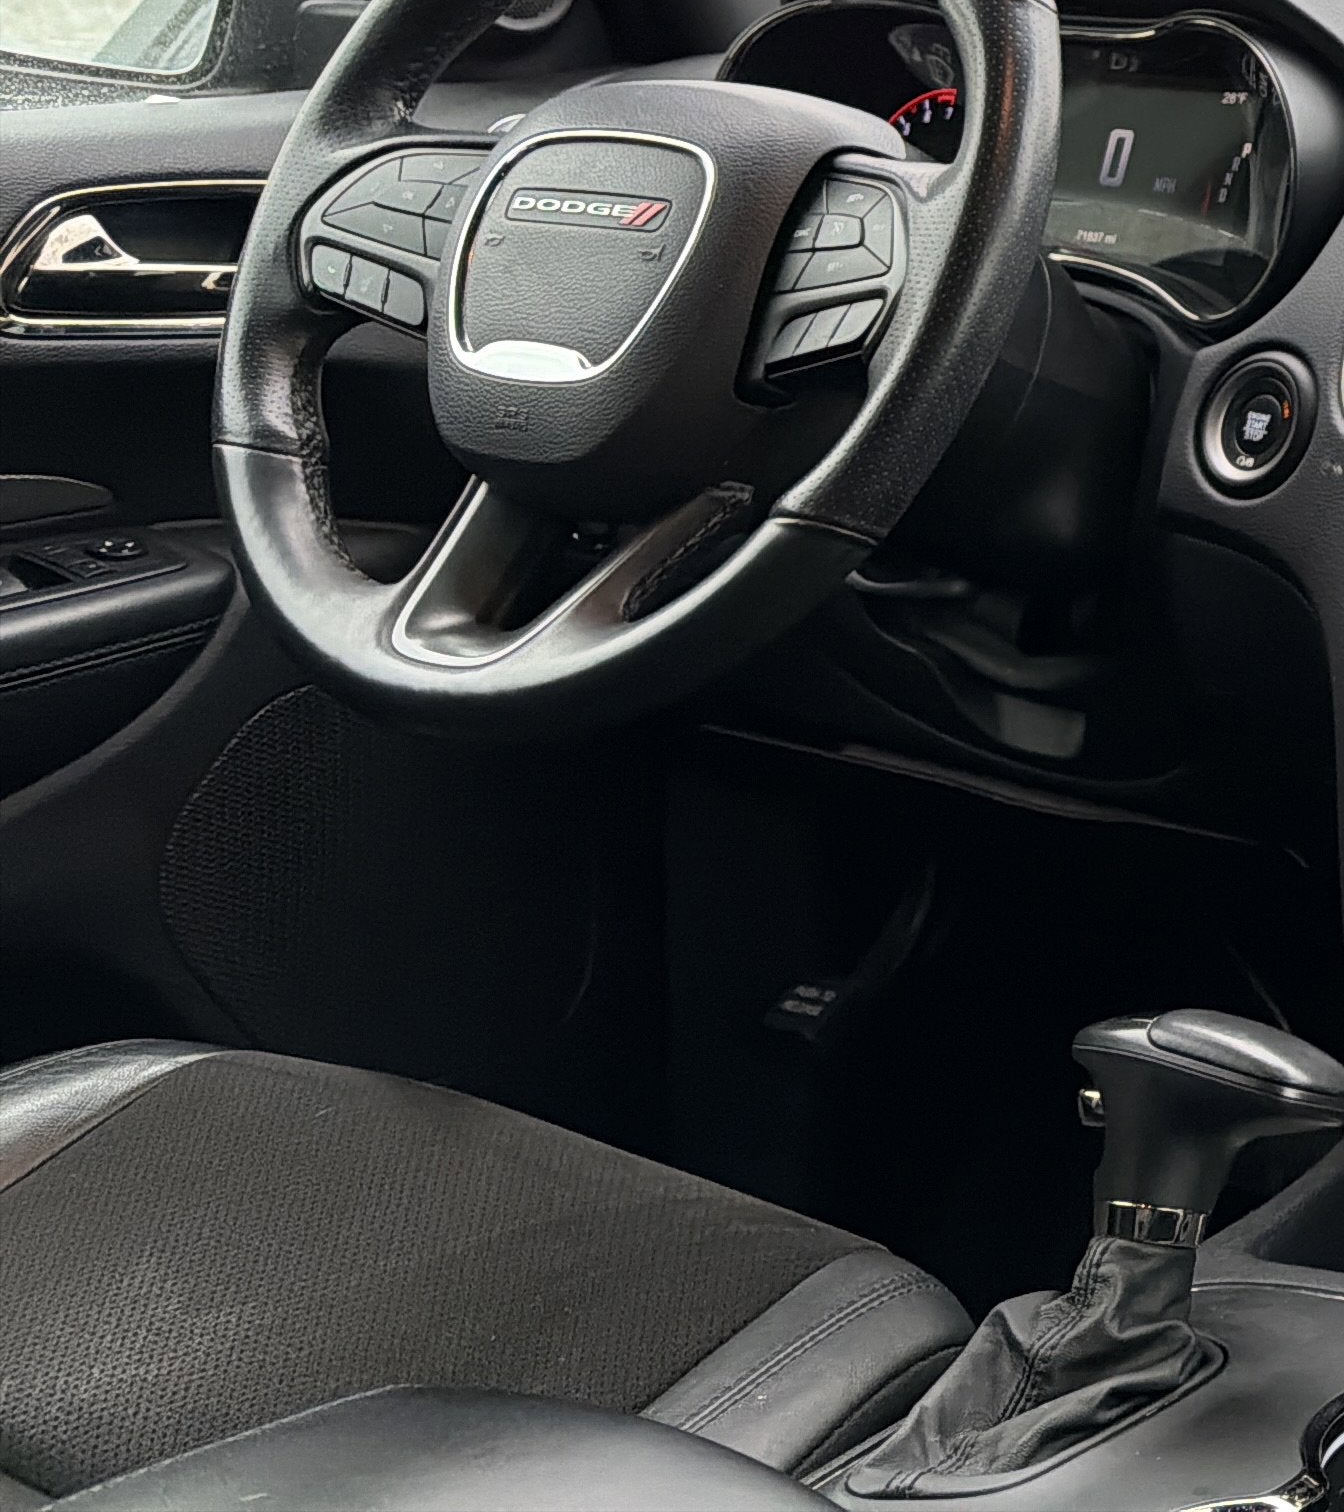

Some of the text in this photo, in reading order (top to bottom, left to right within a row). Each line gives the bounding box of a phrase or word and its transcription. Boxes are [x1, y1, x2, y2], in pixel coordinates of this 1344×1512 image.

[1099, 128, 1134, 187] 0
[1242, 142, 1252, 159] P
[512, 195, 637, 218] DODGE
